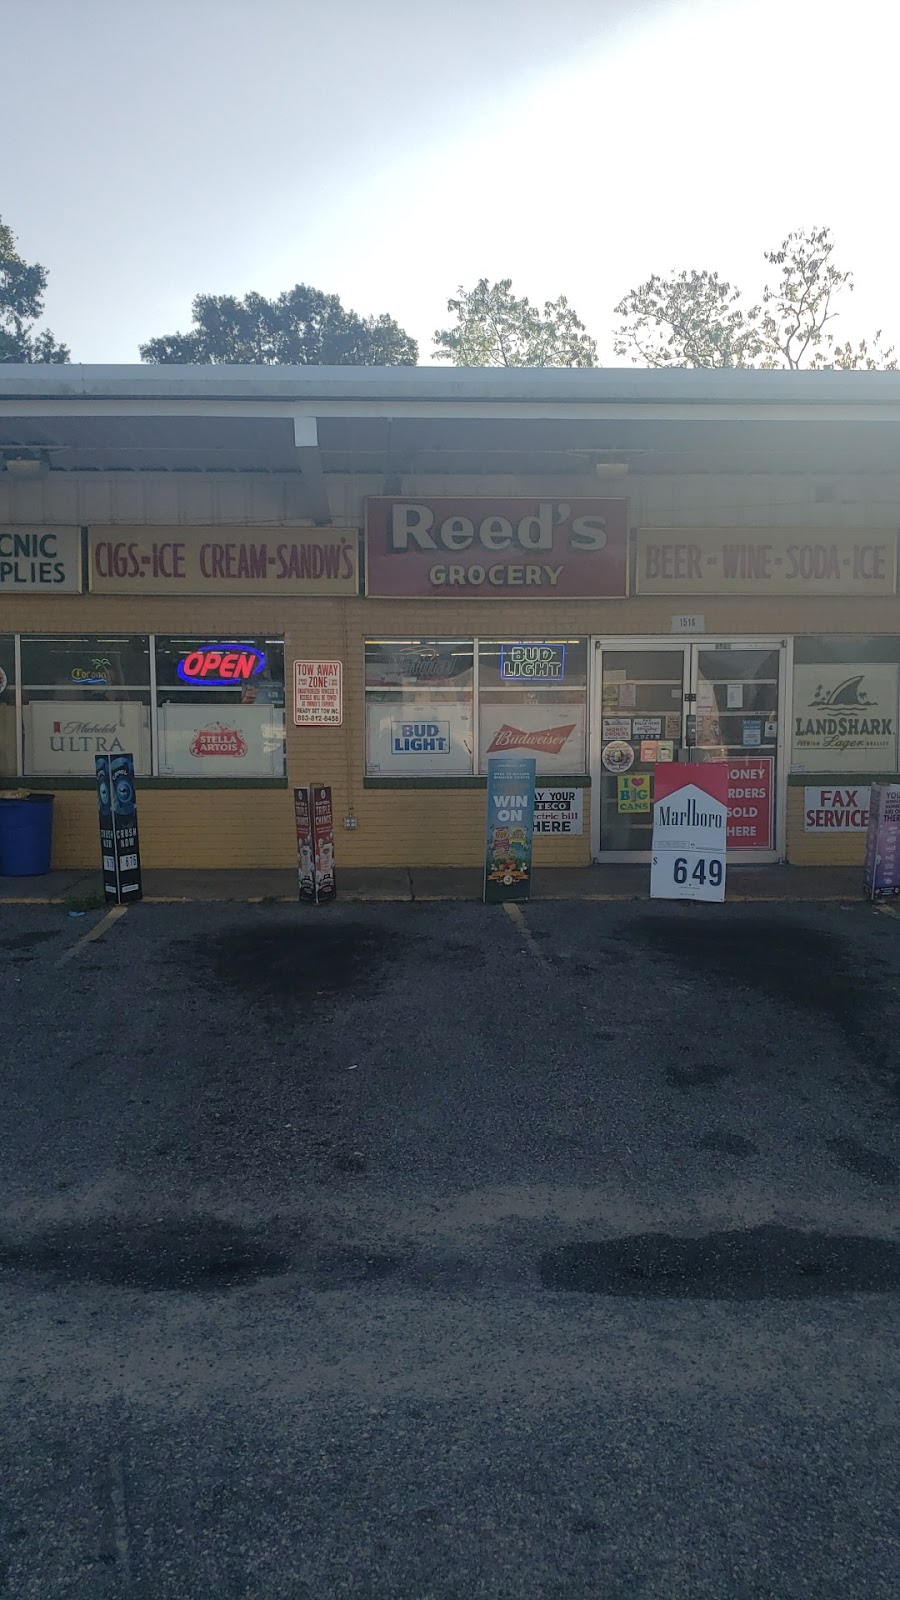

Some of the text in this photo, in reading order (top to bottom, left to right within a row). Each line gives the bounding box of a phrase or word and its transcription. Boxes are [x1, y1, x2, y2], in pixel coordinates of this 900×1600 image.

[391, 503, 608, 551] Reed's
[0, 562, 66, 583] PLIES
[429, 564, 565, 586] GROCERY
[679, 618, 696, 627] 1516
[511, 646, 554, 662] BUD
[183, 652, 257, 679] OPEN
[297, 664, 338, 676] TOW AWAY
[503, 661, 562, 677] LIGHT
[71, 667, 107, 680] Corona
[308, 676, 328, 688] ZONE
[401, 724, 440, 738] BUD
[795, 717, 893, 736] LANDSHARK
[50, 736, 126, 752] ULTRA
[200, 735, 237, 743] STELLA
[394, 737, 447, 751] LIGHT
[493, 730, 569, 747] Budweiser
[823, 735, 865, 751] Lager
[200, 743, 238, 751] ARTOIS
[727, 768, 766, 780] ONEY
[493, 795, 528, 808] WIN
[549, 791, 575, 801] YOUR
[820, 790, 858, 808] FAX
[536, 802, 567, 810] TECO
[620, 802, 649, 811] CANS
[726, 806, 758, 817] SOLD
[497, 809, 523, 822] ON
[561, 812, 578, 820] bill
[659, 798, 722, 829] Marlboro
[806, 809, 869, 828] SERVICE
[116, 827, 137, 839] CRUSH
[532, 821, 571, 832] HERE
[726, 826, 757, 837] HERE
[120, 837, 134, 848] NOW
